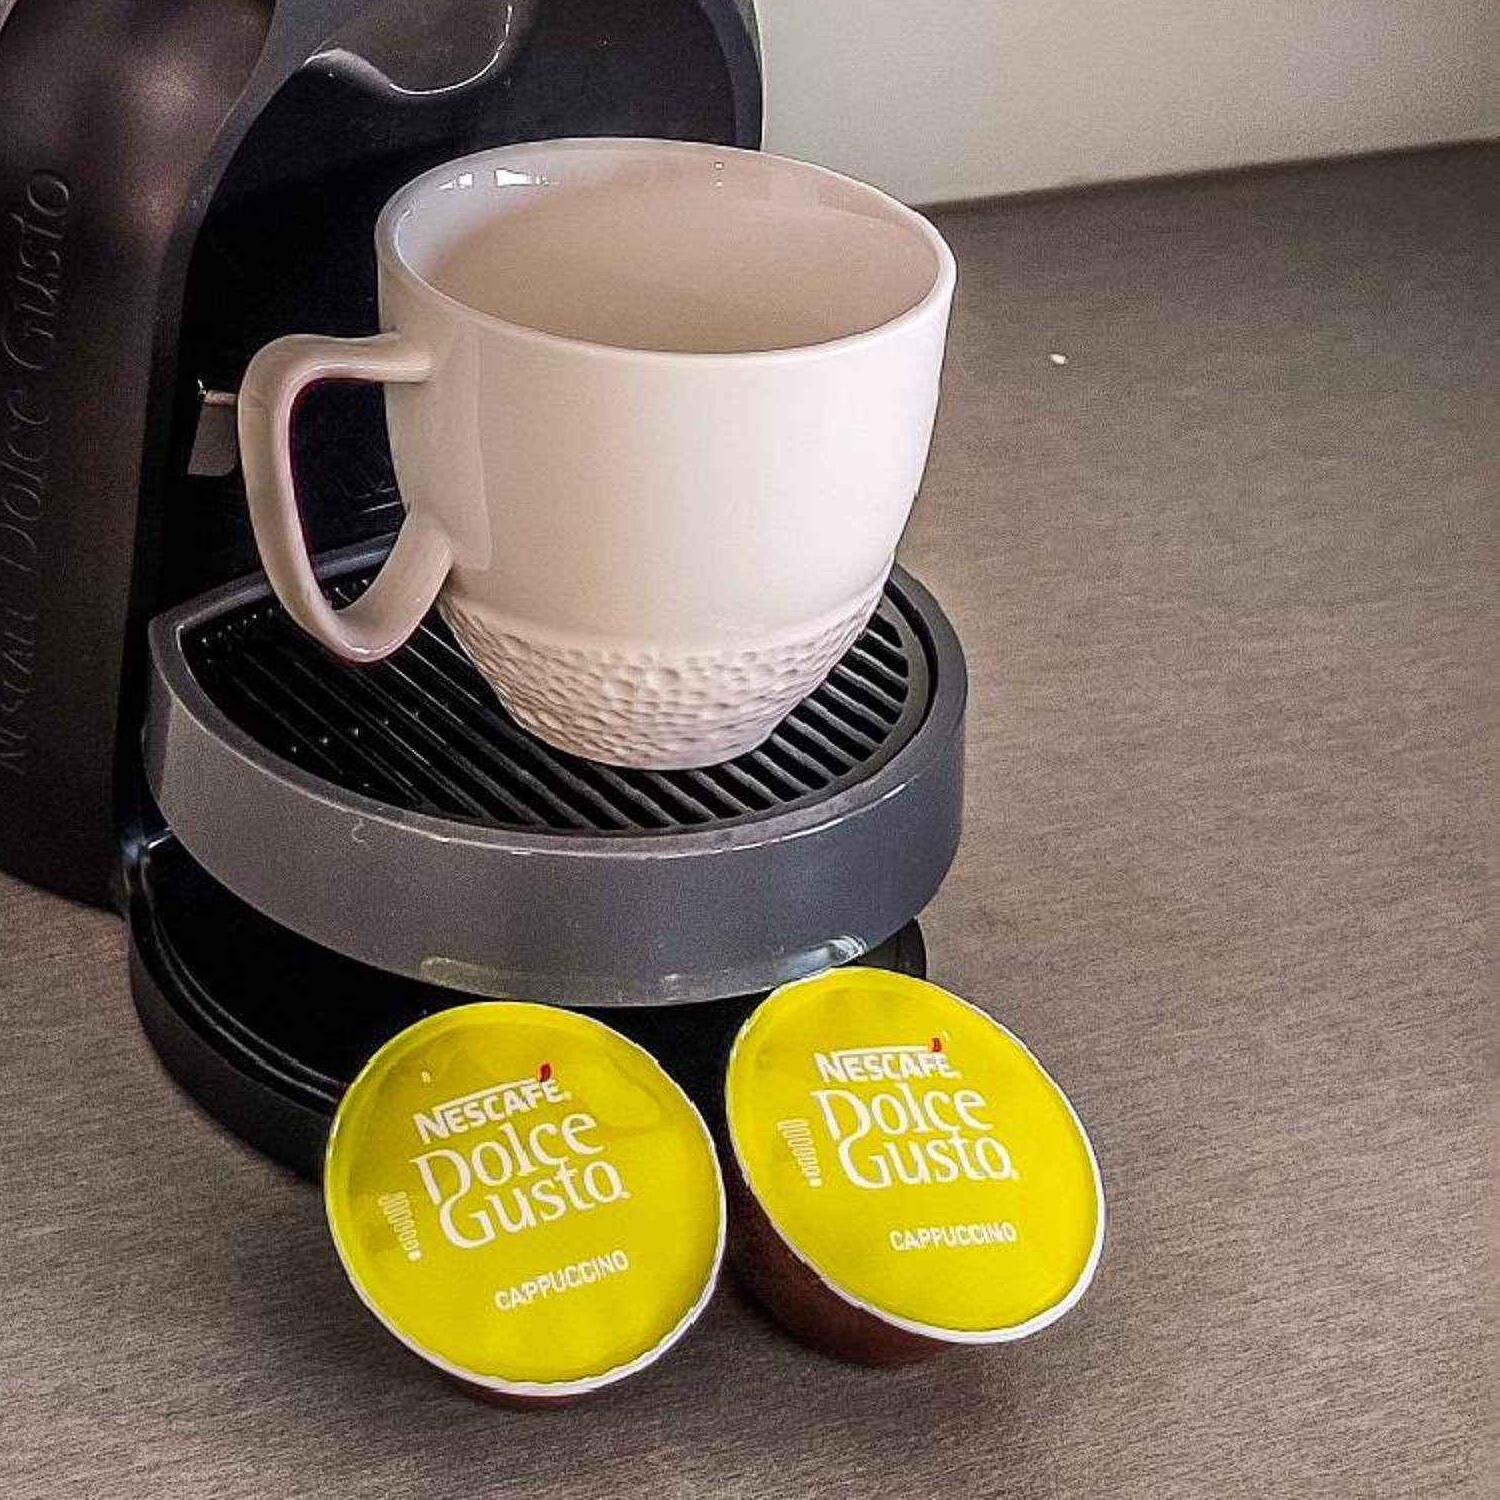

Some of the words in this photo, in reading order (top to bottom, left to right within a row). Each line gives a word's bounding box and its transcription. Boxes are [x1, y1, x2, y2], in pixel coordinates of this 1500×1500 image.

[2, 168, 71, 371] Gusto
[810, 1084, 994, 1140] Dolce
[410, 1113, 603, 1205] Dolce
[837, 1127, 1016, 1188] Gusto
[439, 1161, 627, 1249] Gusto
[889, 1221, 1018, 1250] CAPPUCCINO
[494, 1250, 629, 1311] CAPPUCCINO
